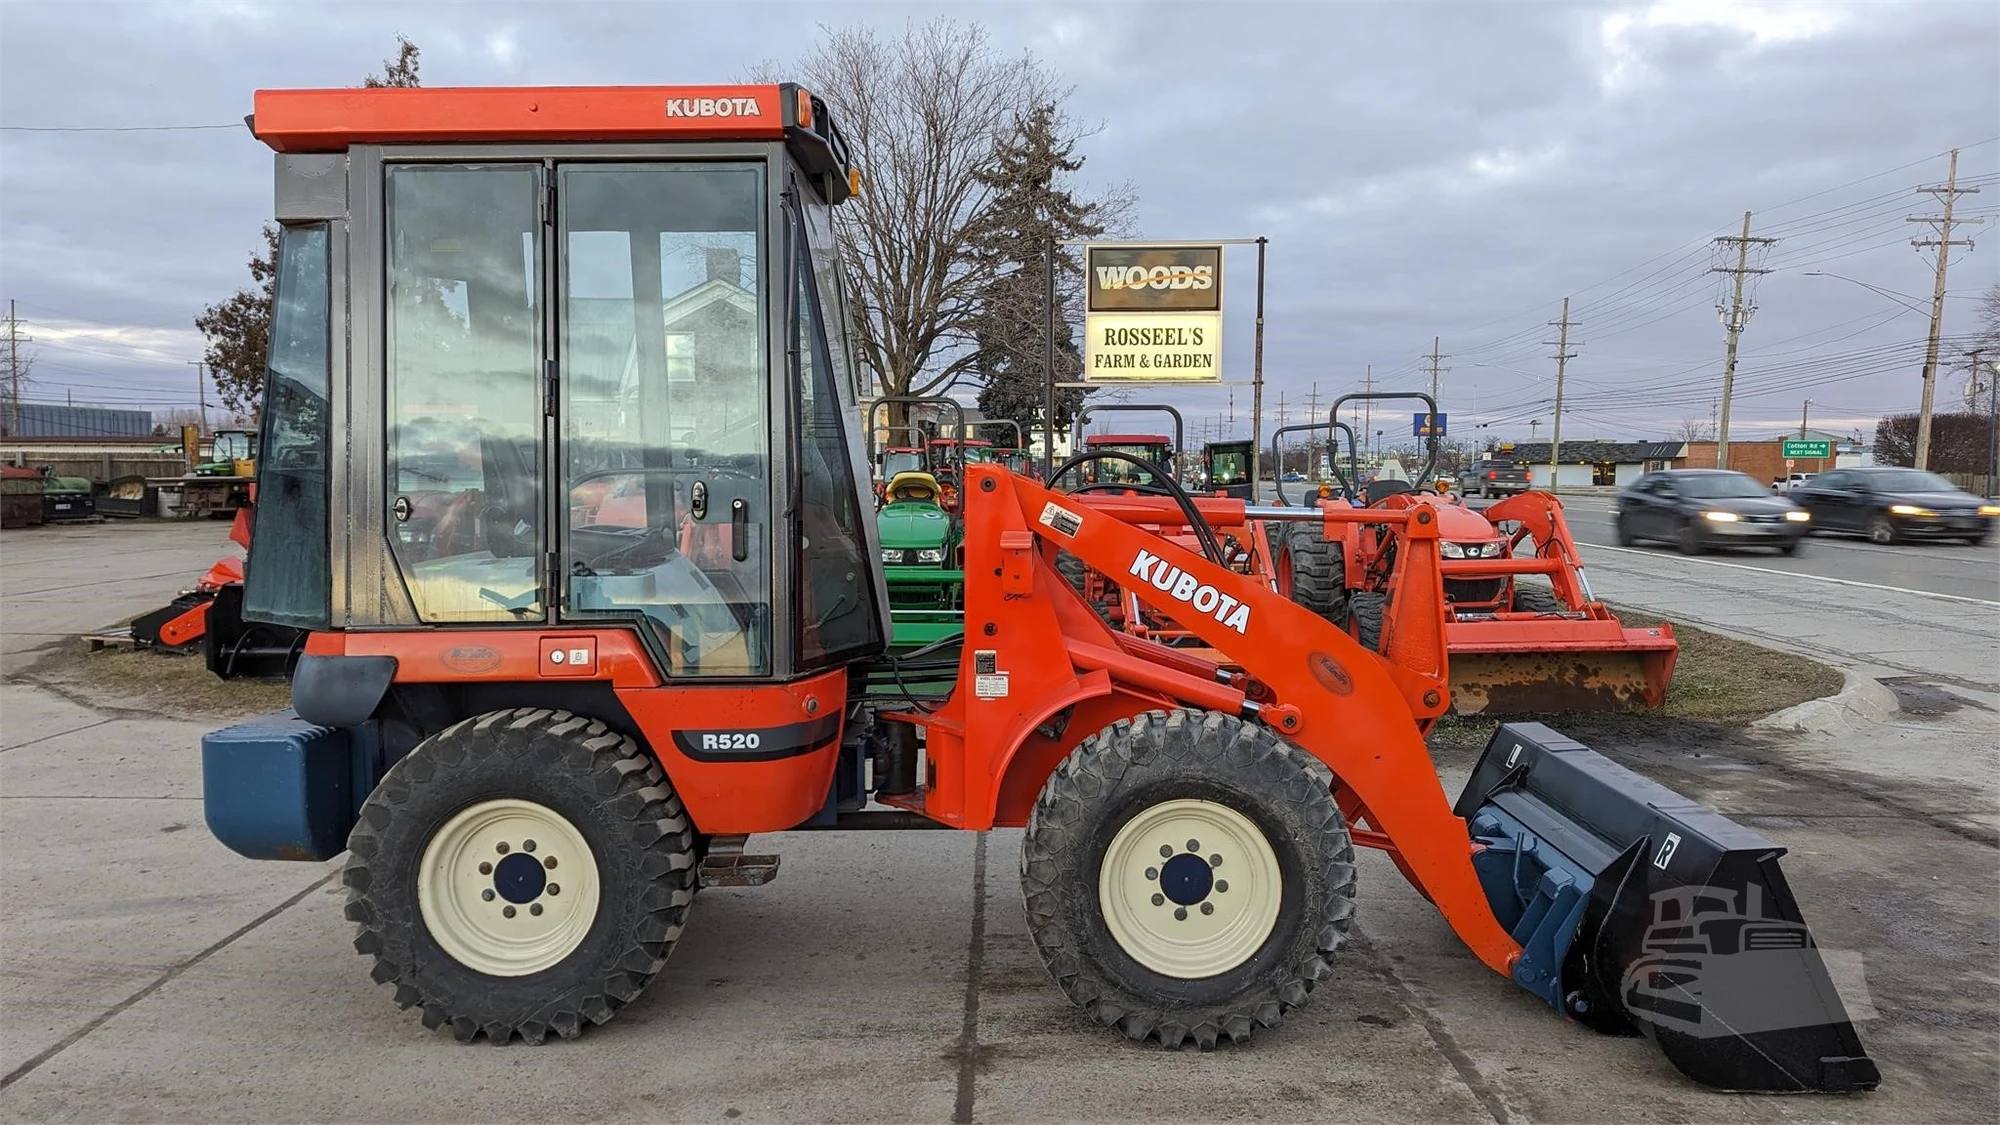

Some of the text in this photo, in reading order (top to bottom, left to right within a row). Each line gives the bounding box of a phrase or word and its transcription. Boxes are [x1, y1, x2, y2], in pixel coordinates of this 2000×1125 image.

[666, 98, 761, 117] KUBOTA
[1096, 265, 1212, 290] WOODS
[1104, 327, 1204, 346] ROSSEEL'S
[1094, 354, 1212, 368] FARM & GARDEN
[1128, 548, 1251, 635] KUBOTA
[702, 733, 760, 750] R520
[1656, 838, 1675, 868] R
